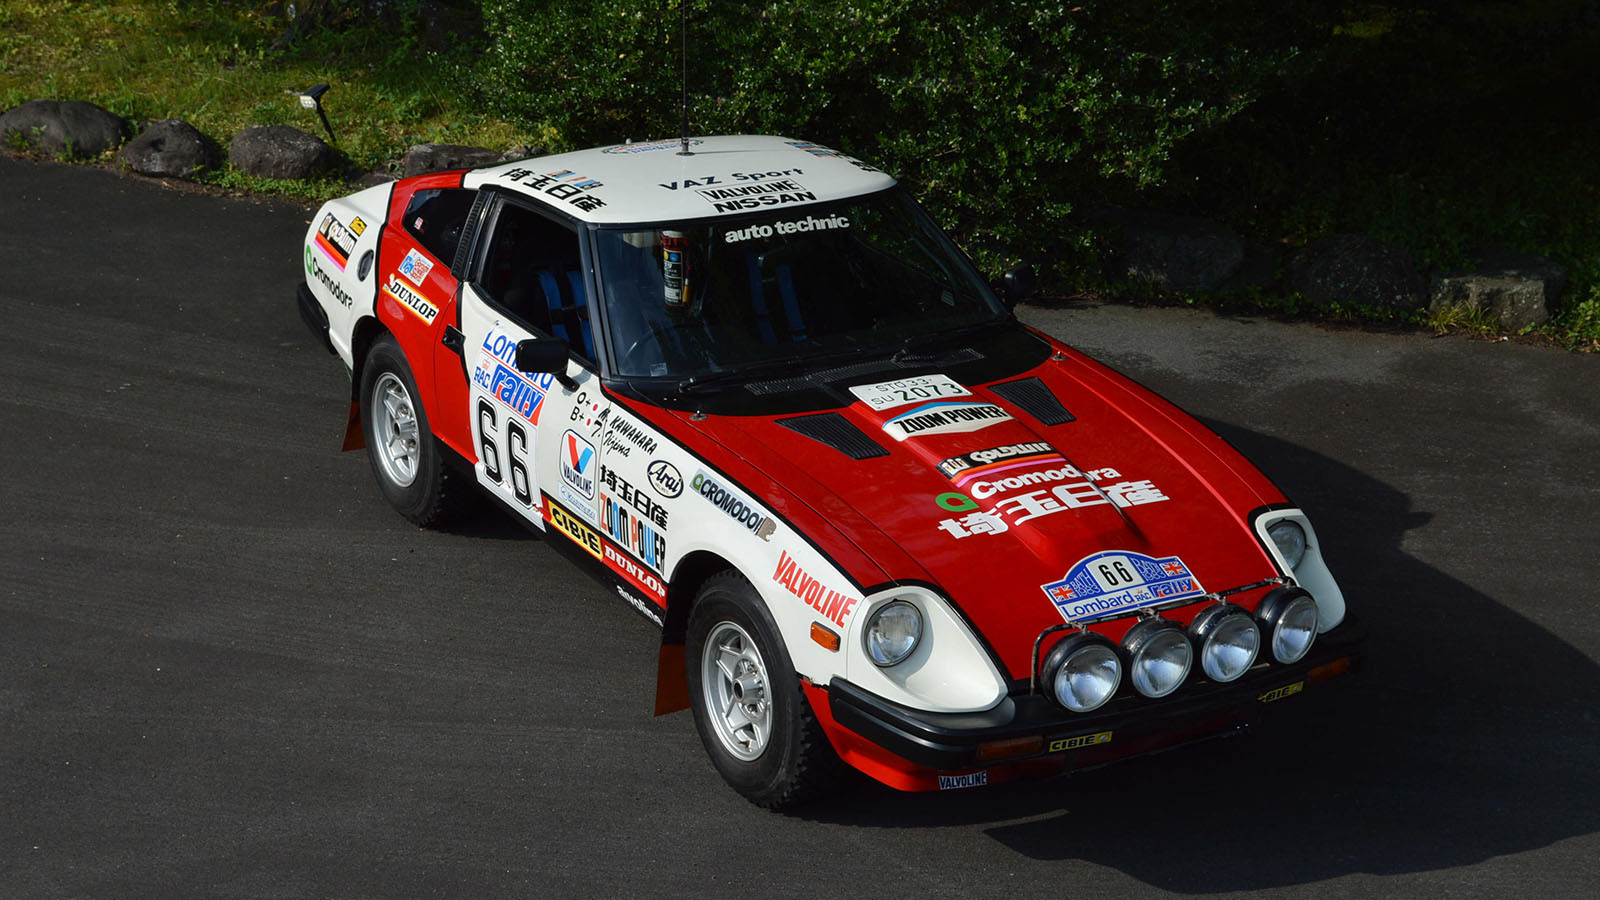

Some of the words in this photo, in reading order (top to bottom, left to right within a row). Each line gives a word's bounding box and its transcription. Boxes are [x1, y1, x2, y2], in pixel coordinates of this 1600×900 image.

[499, 167, 607, 213] 埼玉日産
[659, 176, 722, 191] VAZ
[731, 168, 803, 181] Sport
[701, 180, 800, 201] VALVOLINE
[713, 192, 817, 213] NISSAN
[725, 224, 772, 244] auto
[774, 213, 850, 235] technic
[391, 281, 437, 320] DUNLOP
[474, 366, 491, 389] RAC
[491, 371, 545, 419] rally
[871, 395, 896, 405] SU
[894, 383, 964, 402] 2073
[908, 378, 928, 387] 33
[570, 406, 584, 421] B+
[577, 392, 591, 407] O+
[609, 415, 658, 456] KAWAHARA
[894, 415, 950, 434] ZOOM
[945, 406, 1009, 423] POWER
[478, 396, 533, 508] 66
[563, 461, 592, 496] VALVOLINE
[648, 464, 682, 493] Arai
[971, 464, 1122, 500] Cromodora
[600, 464, 669, 531] 埼玉日産
[938, 480, 1170, 539] 埼玉日産
[552, 507, 601, 555] CIBIE
[600, 492, 631, 548] ZOOM
[631, 515, 666, 576] POWER
[604, 545, 666, 597] DUNLOP
[1069, 568, 1095, 590] BATH
[1098, 561, 1133, 586] 66
[1131, 558, 1161, 573] BATH
[772, 550, 857, 628] VALVOLINE
[1062, 591, 1135, 617] Lombard
[1134, 593, 1151, 602] RAC
[1152, 578, 1193, 598] rally
[1052, 735, 1096, 750] CIBIE
[939, 773, 987, 789] VALVOLINE
